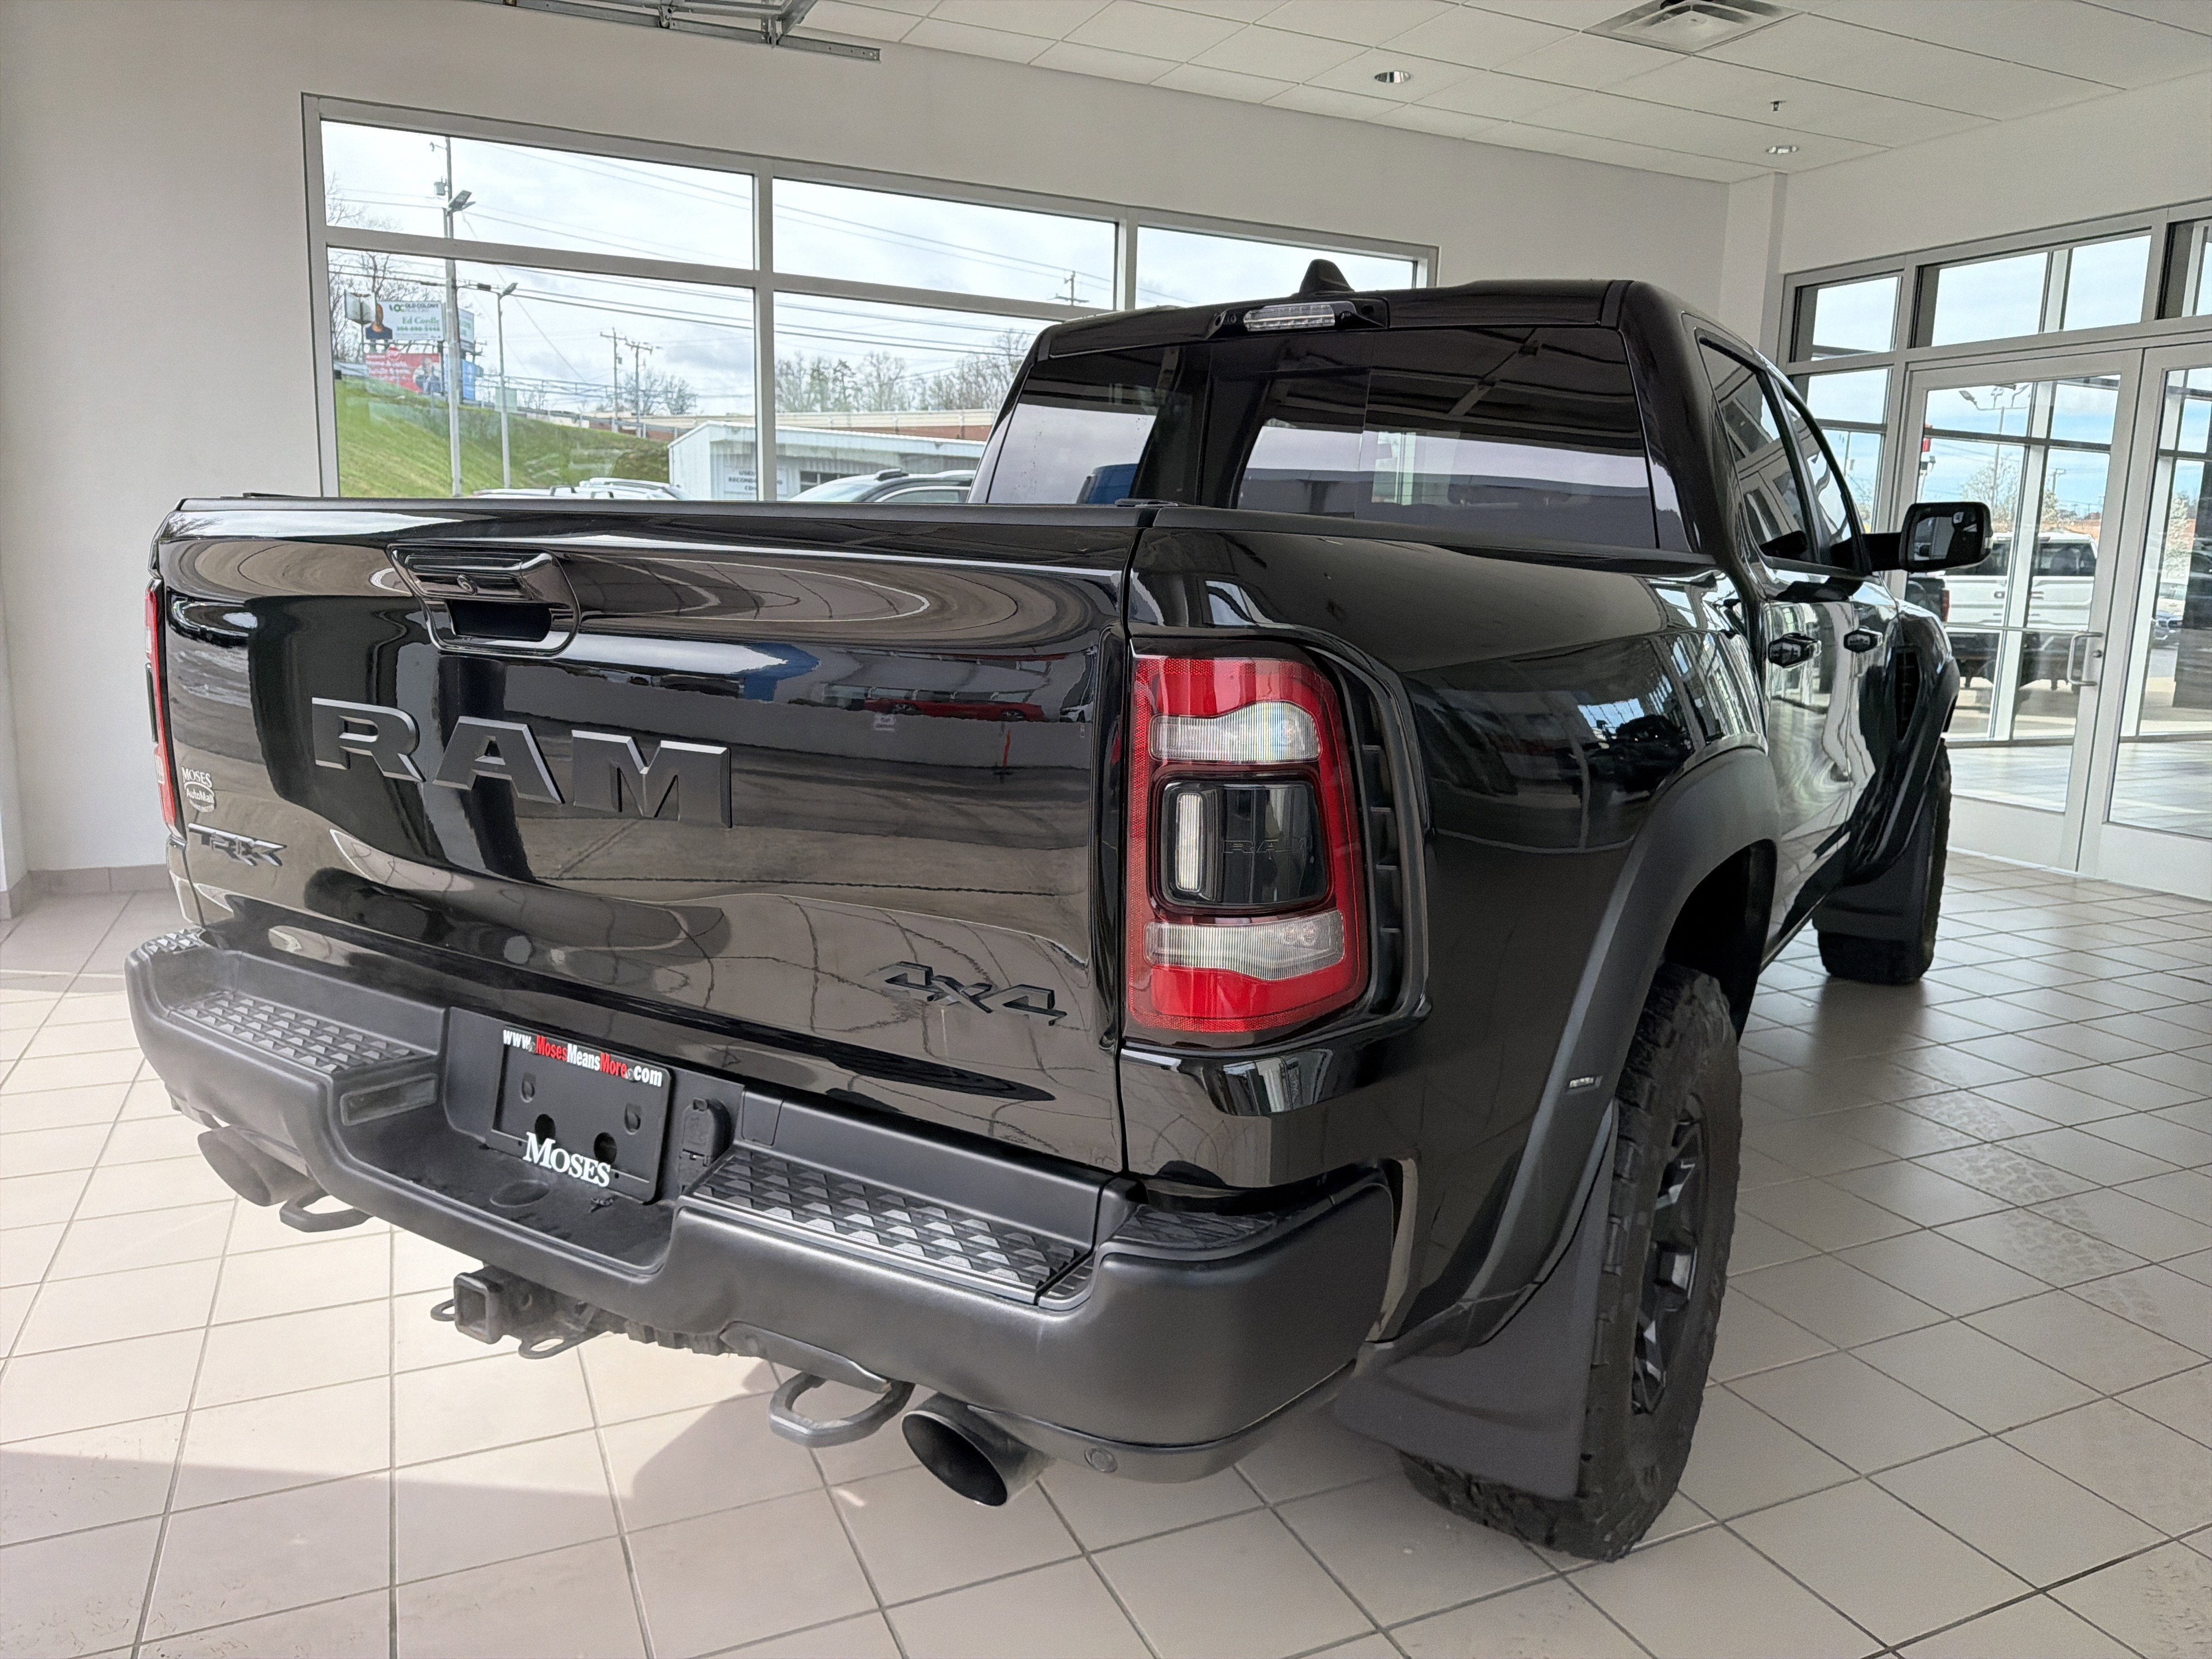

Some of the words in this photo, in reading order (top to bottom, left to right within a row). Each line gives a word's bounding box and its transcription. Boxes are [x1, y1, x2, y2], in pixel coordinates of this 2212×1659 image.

[182, 767, 212, 788] MOSES
[312, 697, 732, 828] RAM
[188, 823, 287, 867] TRX
